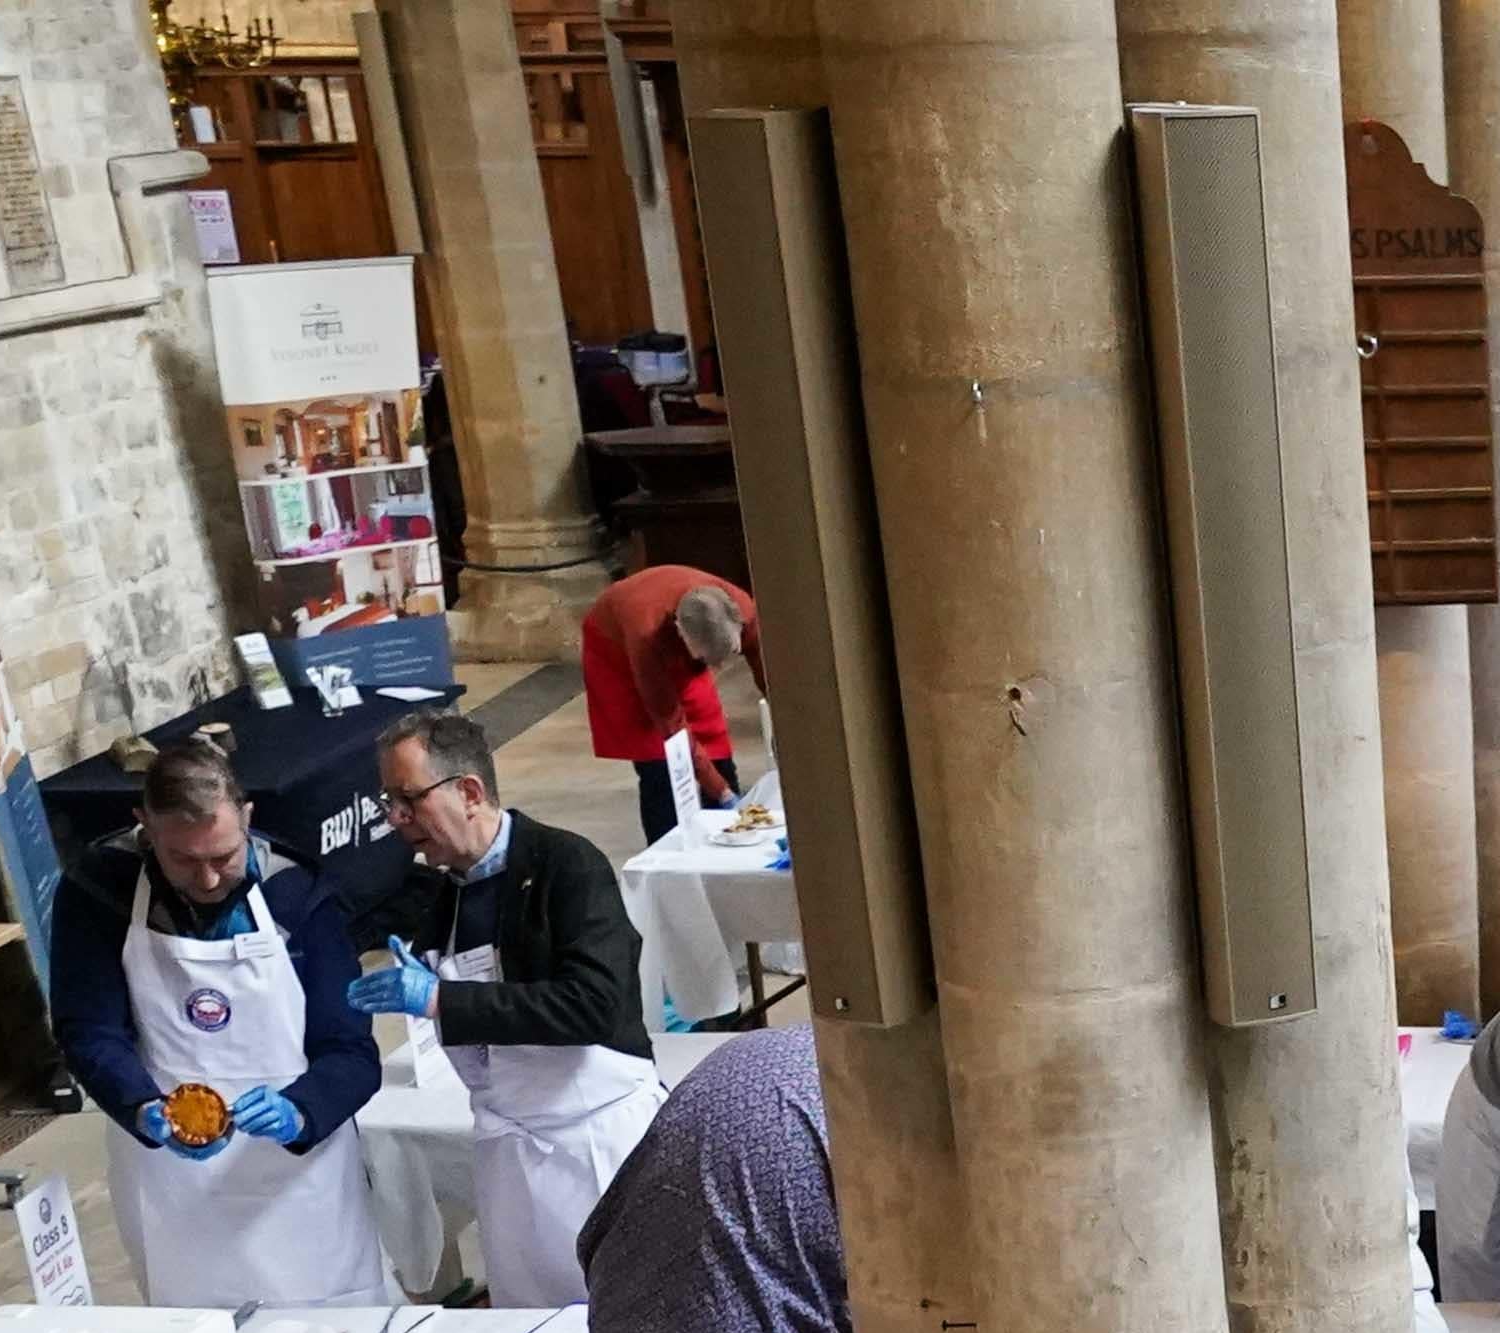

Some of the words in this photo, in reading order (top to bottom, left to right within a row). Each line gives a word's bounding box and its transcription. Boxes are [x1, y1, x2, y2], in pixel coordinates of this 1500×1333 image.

[1374, 228, 1485, 259] PSALMS
[32, 1225, 61, 1258] Class
[60, 1214, 69, 1236] 8
